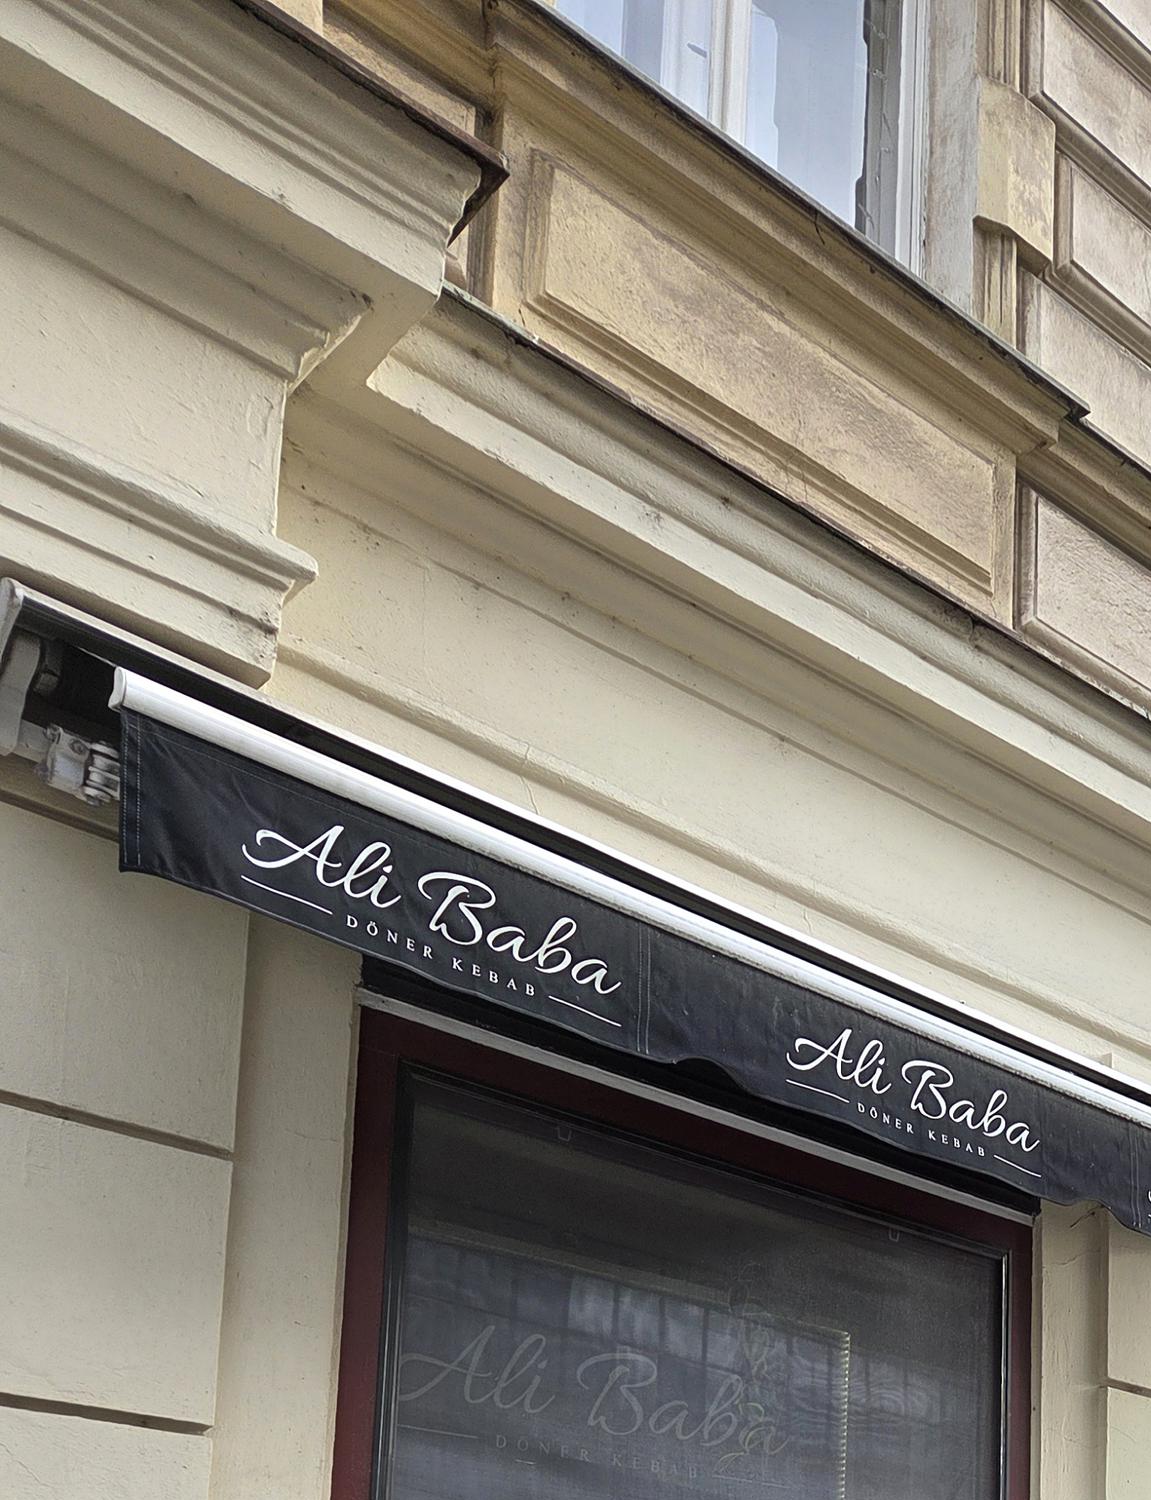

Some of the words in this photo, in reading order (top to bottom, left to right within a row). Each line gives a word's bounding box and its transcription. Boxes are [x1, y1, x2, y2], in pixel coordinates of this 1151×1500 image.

[241, 824, 402, 909] Ali
[417, 871, 622, 995] Baba
[345, 914, 433, 959] DÖNER
[451, 957, 535, 997] KEBAB
[785, 1028, 892, 1096] Ali
[902, 1060, 1040, 1154] Baba
[857, 1101, 915, 1134] DÖNER
[928, 1129, 987, 1158] KEBAB
[399, 1324, 556, 1414] Ali
[576, 1352, 790, 1456] Baba
